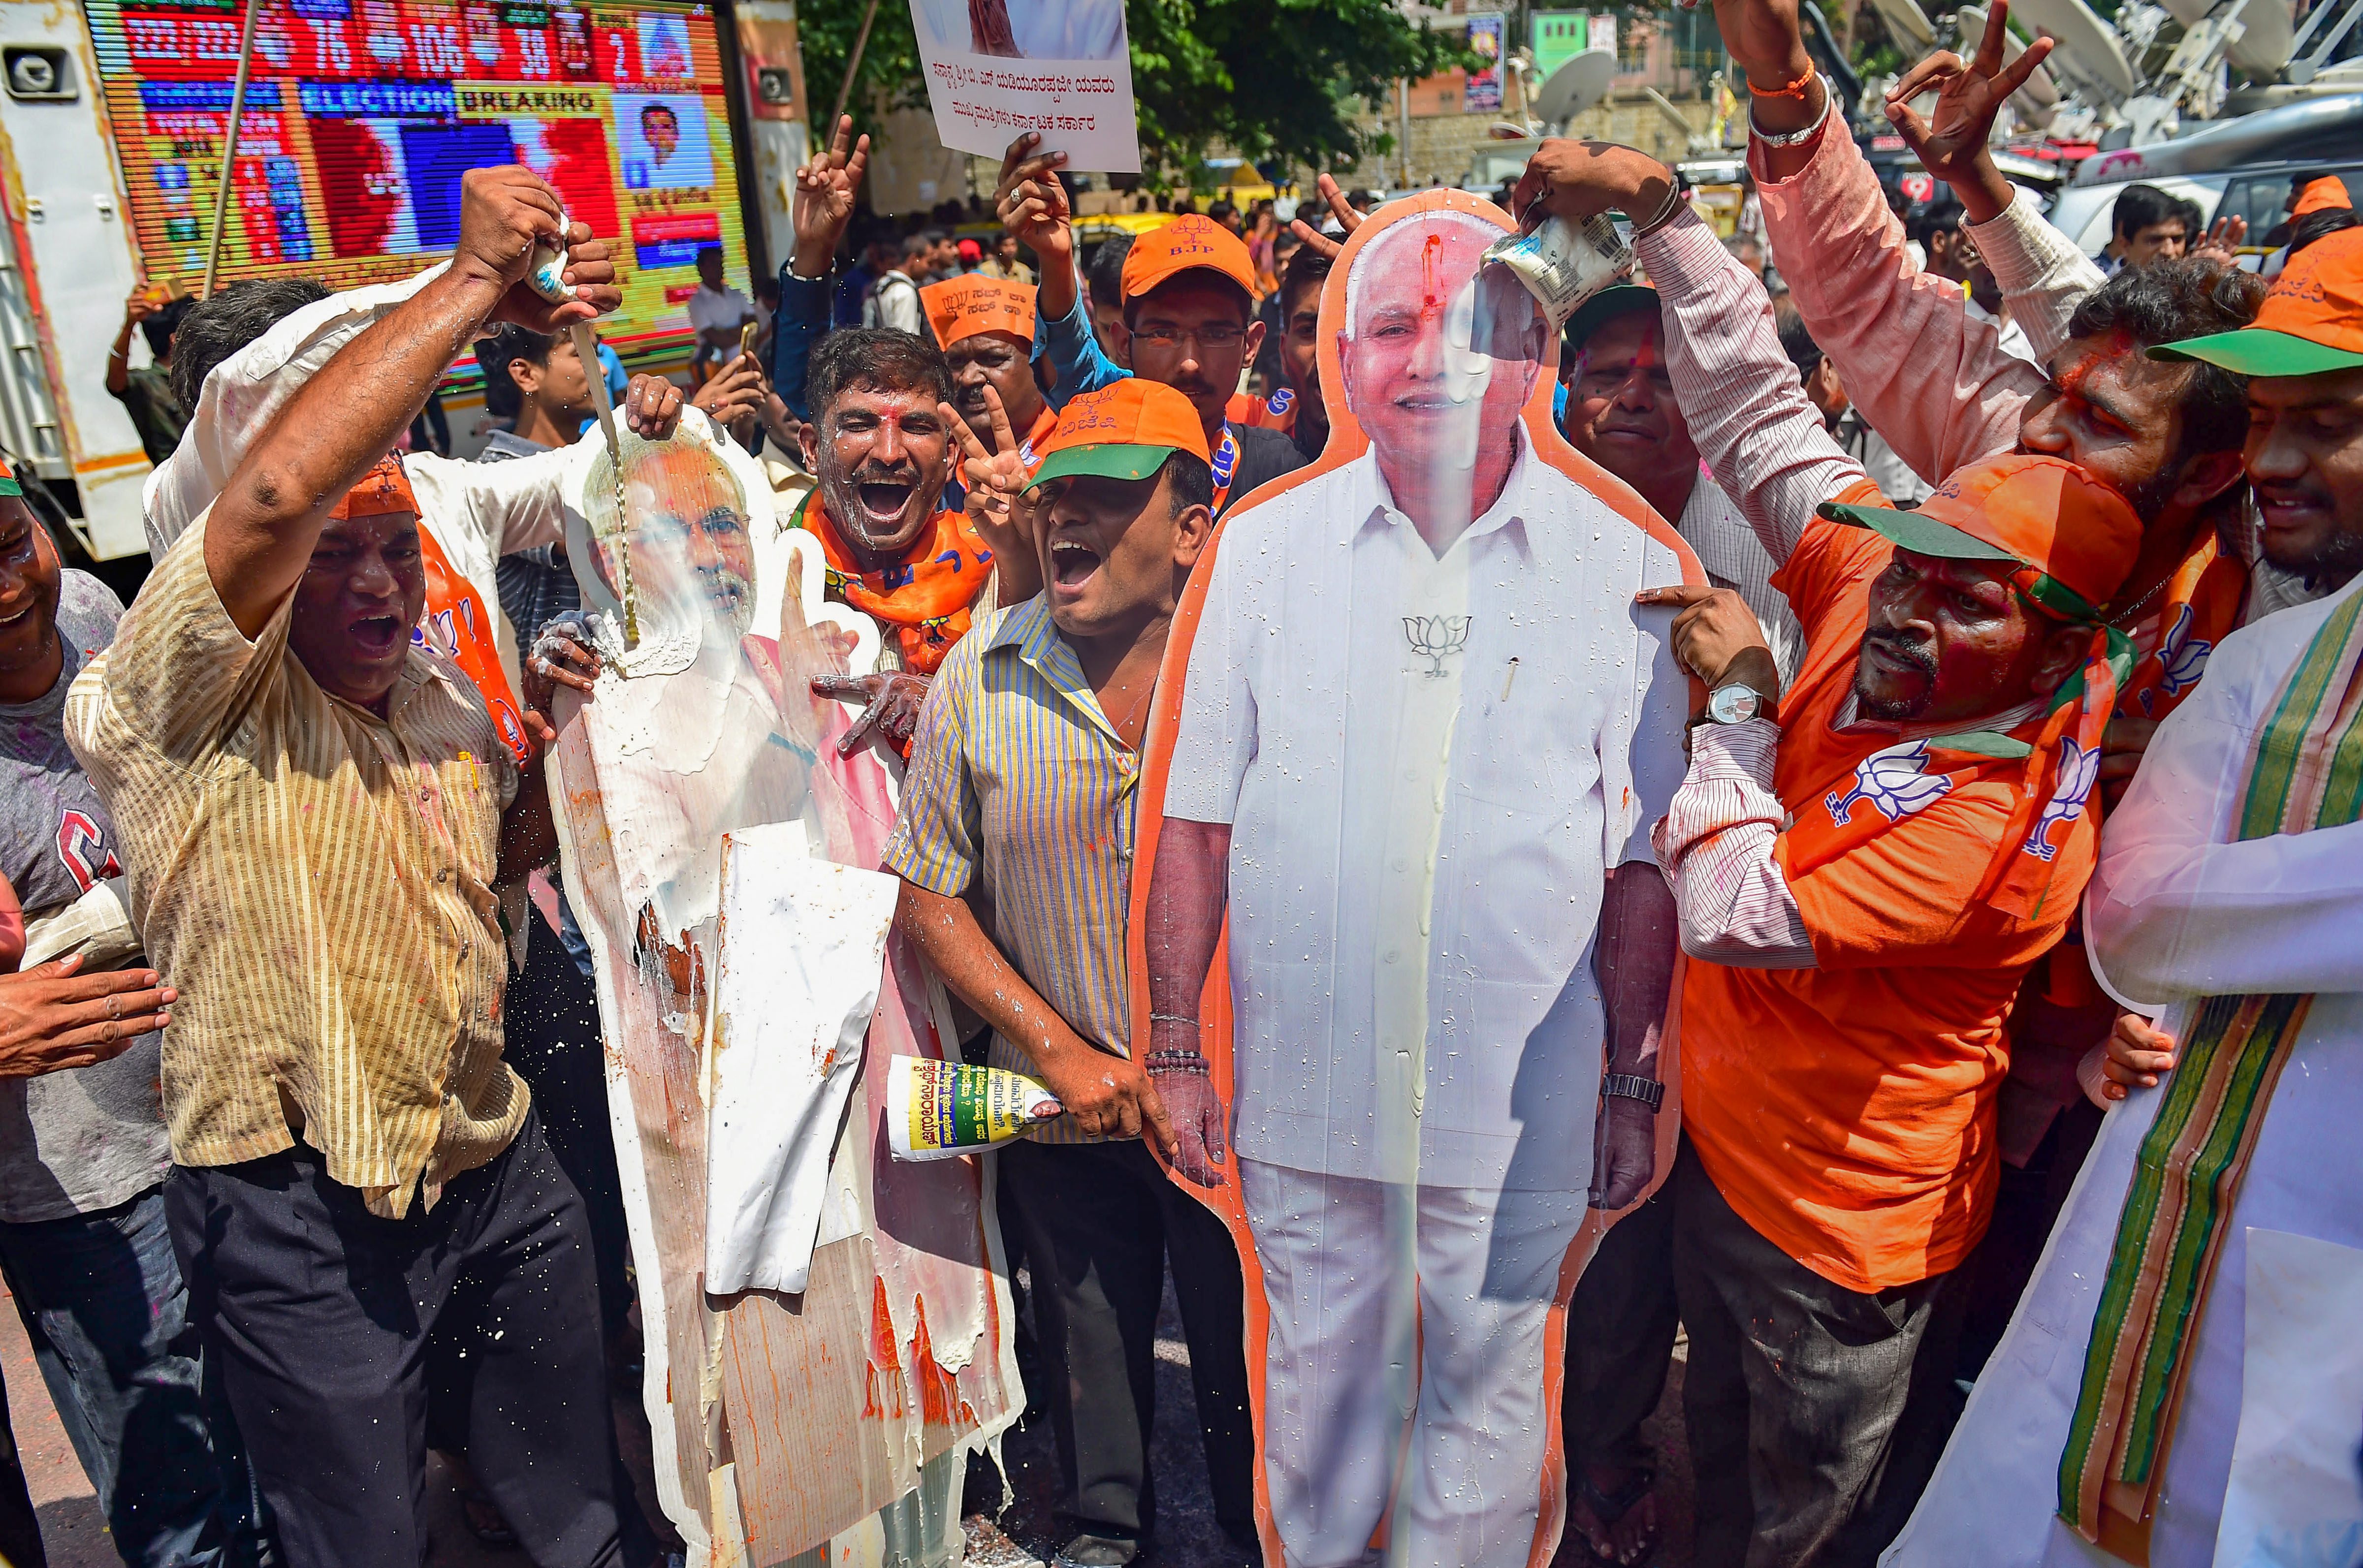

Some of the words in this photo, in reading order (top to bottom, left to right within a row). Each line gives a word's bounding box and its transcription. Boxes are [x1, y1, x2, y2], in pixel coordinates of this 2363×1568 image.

[302, 87, 452, 113] ELECTION
[459, 91, 595, 112] BREAKING
[1056, 113, 1095, 130] ಸರ್ಕಾರ
[1170, 245, 1214, 256] BJP
[1061, 415, 1118, 437] ಬಿಜೆಪಿ
